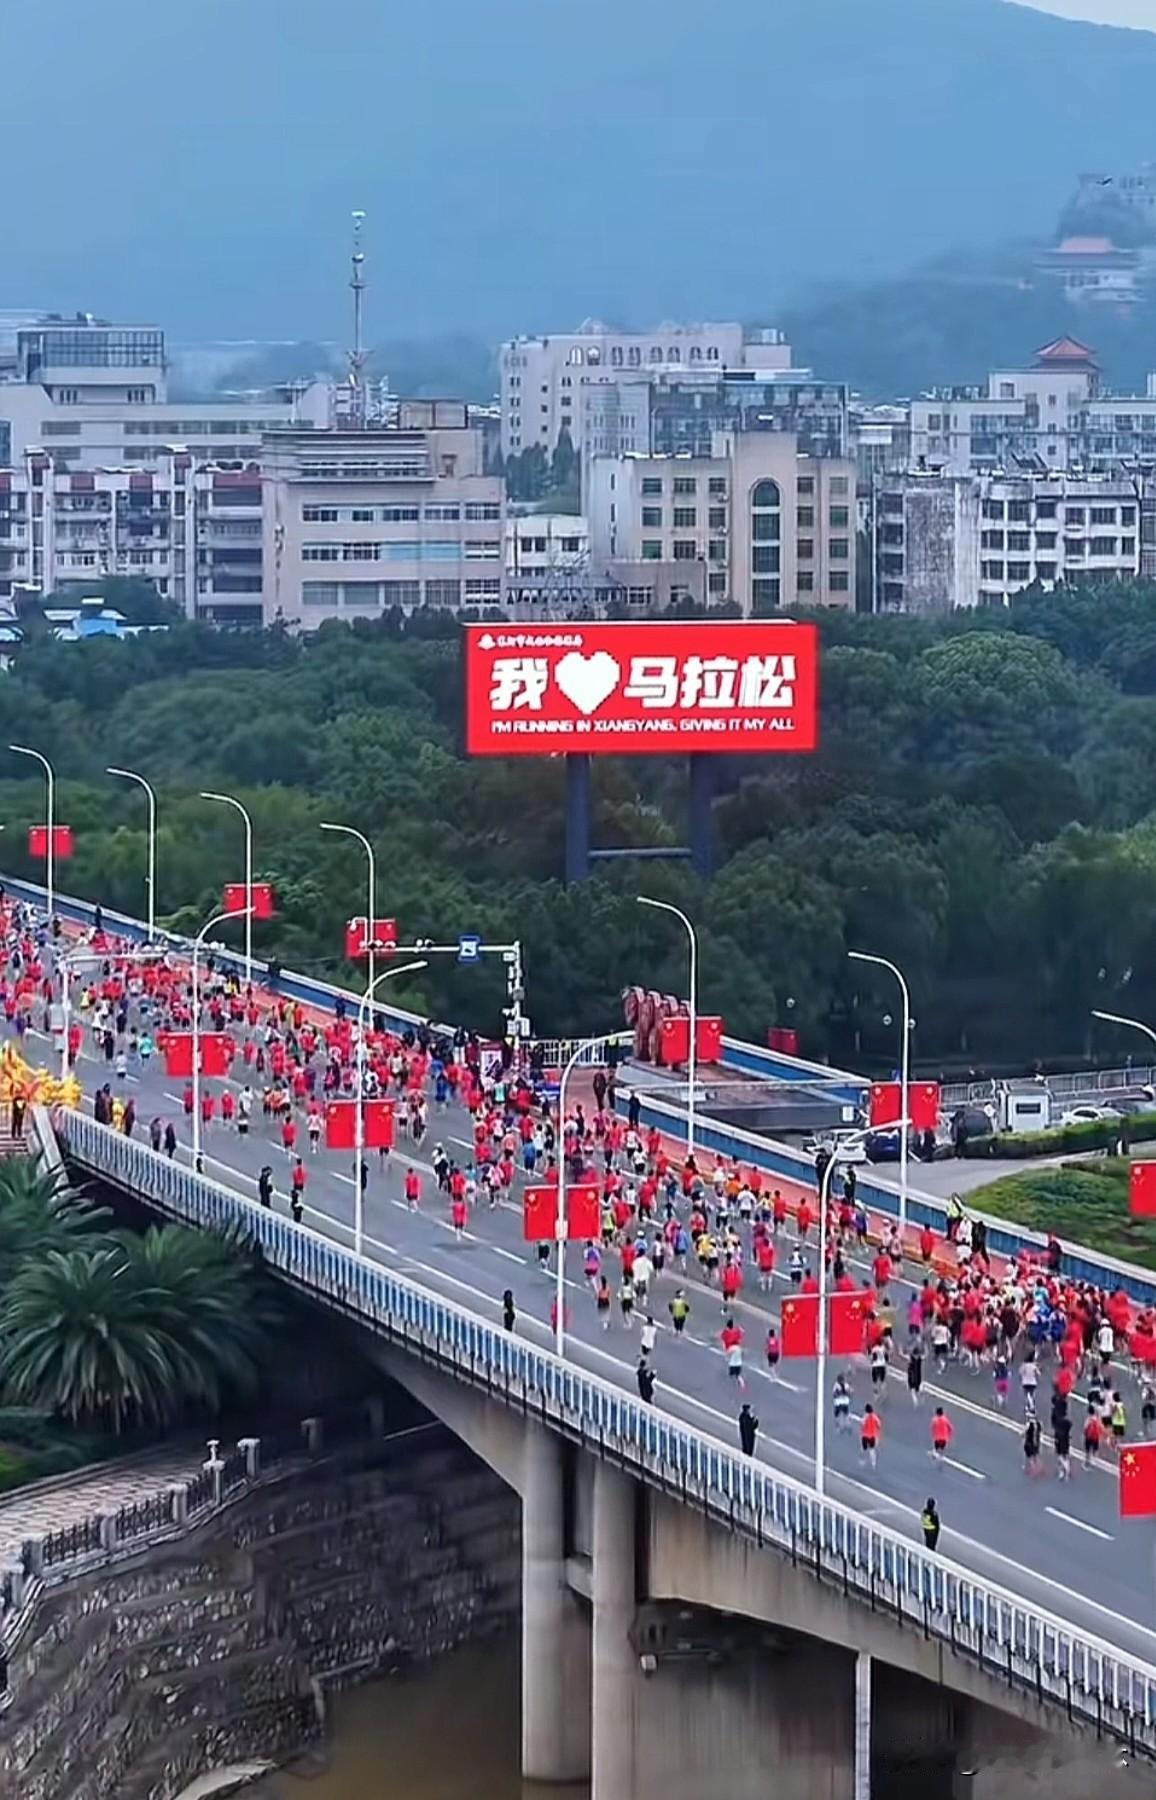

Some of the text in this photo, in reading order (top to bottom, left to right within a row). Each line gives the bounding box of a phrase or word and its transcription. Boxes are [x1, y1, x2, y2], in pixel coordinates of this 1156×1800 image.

[489, 655, 796, 711] 我 马拉松
[513, 720, 574, 733] RUNNING
[576, 719, 592, 732] IN
[679, 718, 727, 732] GIVING
[728, 718, 741, 731] IT
[743, 718, 766, 731] MY
[768, 717, 795, 731] ALL
